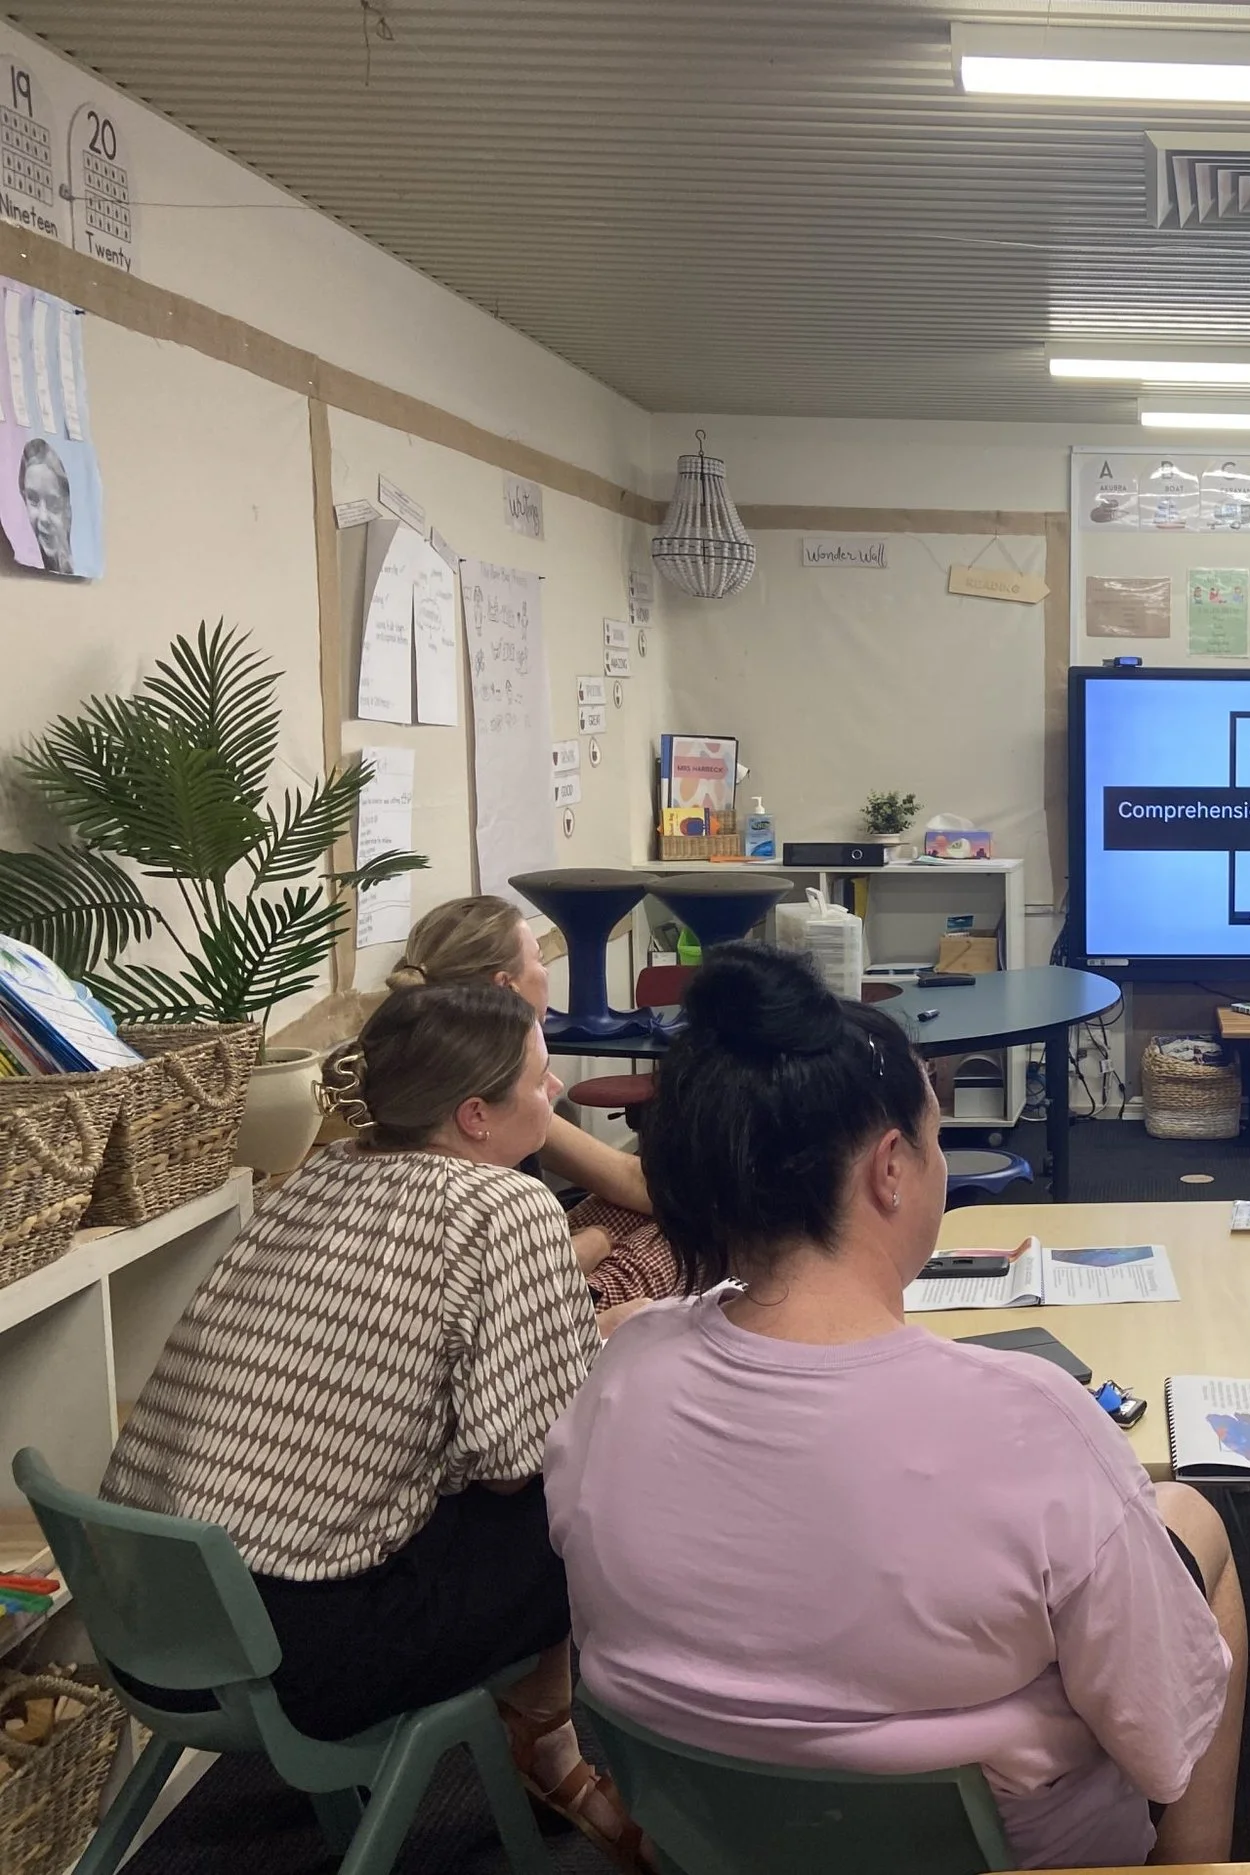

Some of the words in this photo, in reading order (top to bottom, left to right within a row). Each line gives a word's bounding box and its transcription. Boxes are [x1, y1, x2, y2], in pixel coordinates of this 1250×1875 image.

[10, 64, 33, 118] 19
[87, 110, 117, 160] 20
[0, 192, 58, 238] Nineteen
[85, 230, 132, 272] Twenty
[1099, 460, 1114, 479] A
[1221, 461, 1237, 480] C
[806, 546, 857, 564] Wonder
[858, 543, 886, 568] Wall
[965, 577, 1020, 595] READING
